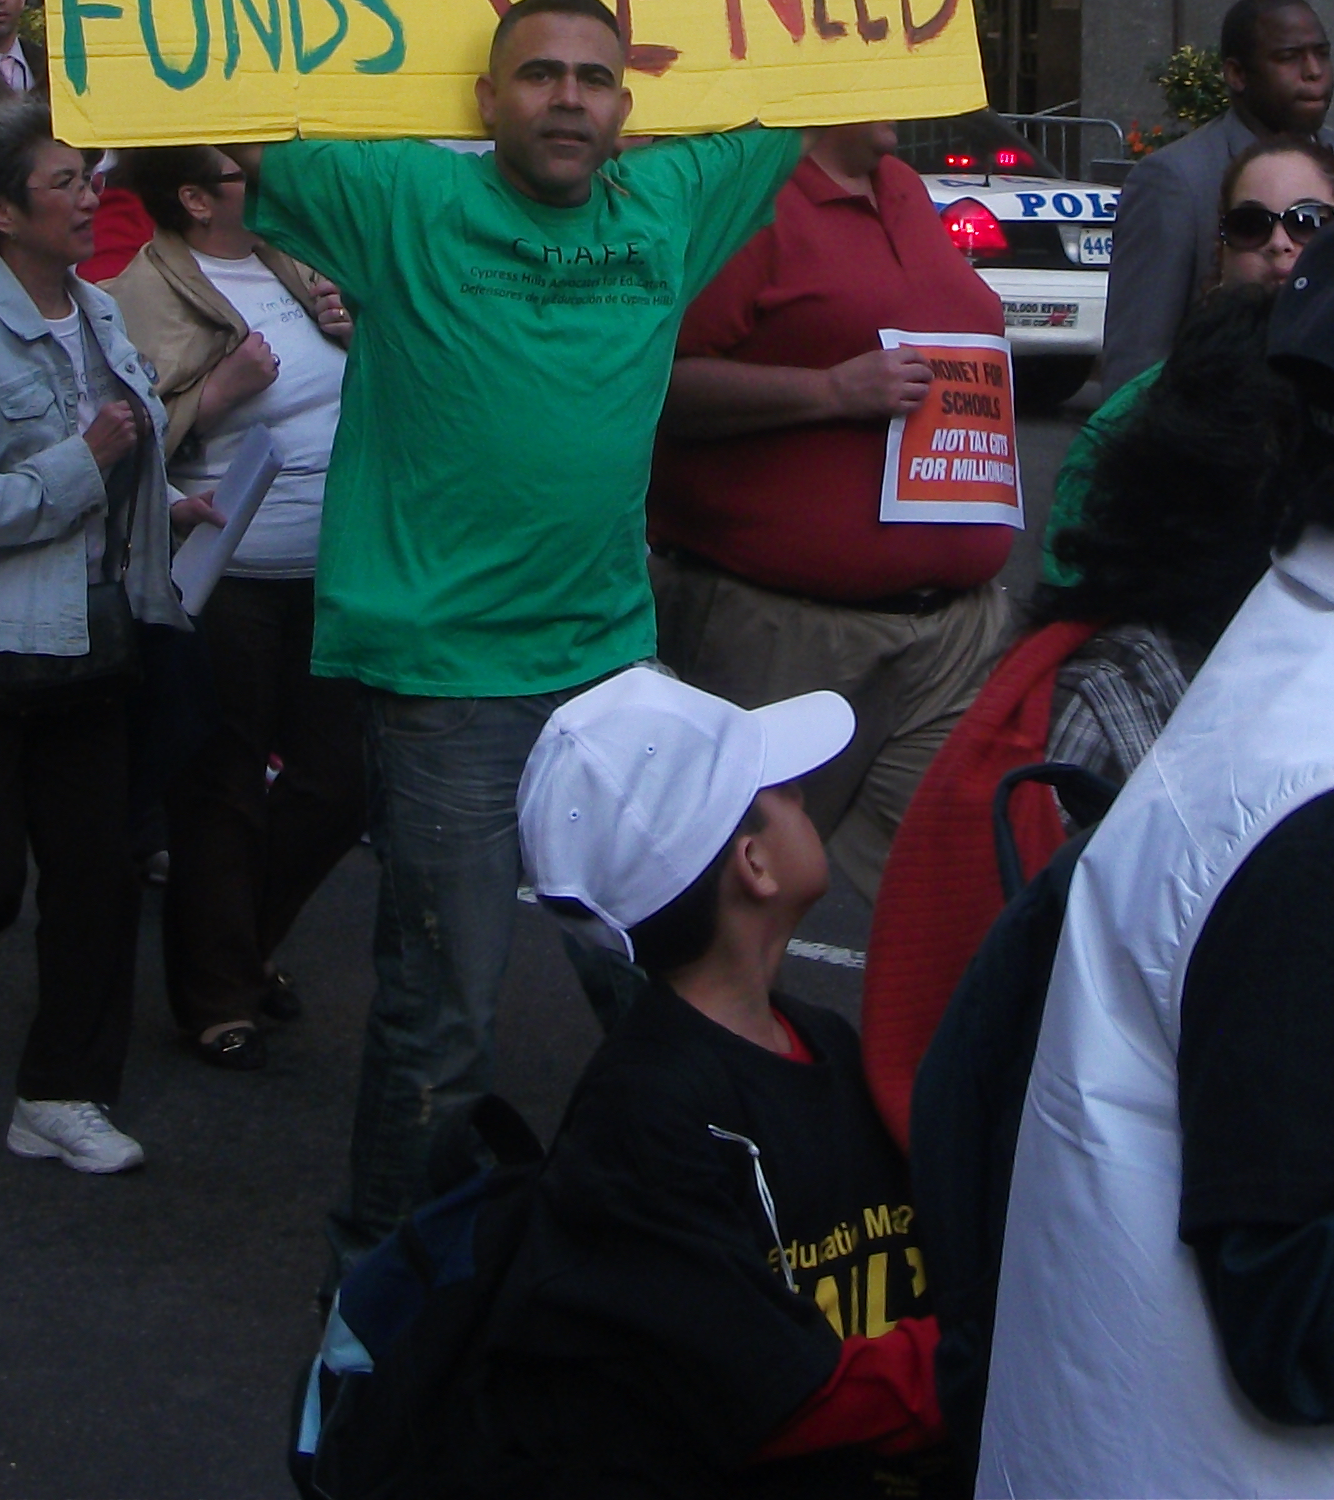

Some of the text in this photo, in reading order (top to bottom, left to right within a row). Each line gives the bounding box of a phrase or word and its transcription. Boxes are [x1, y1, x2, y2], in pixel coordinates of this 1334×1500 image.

[1014, 192, 1120, 219] POL
[470, 266, 518, 283] Cypress
[930, 358, 1003, 388] MONEY FOR
[941, 390, 1001, 420] SCHOOLS
[931, 428, 967, 451] NOT
[967, 429, 988, 454] TAX
[909, 457, 947, 481] FOR
